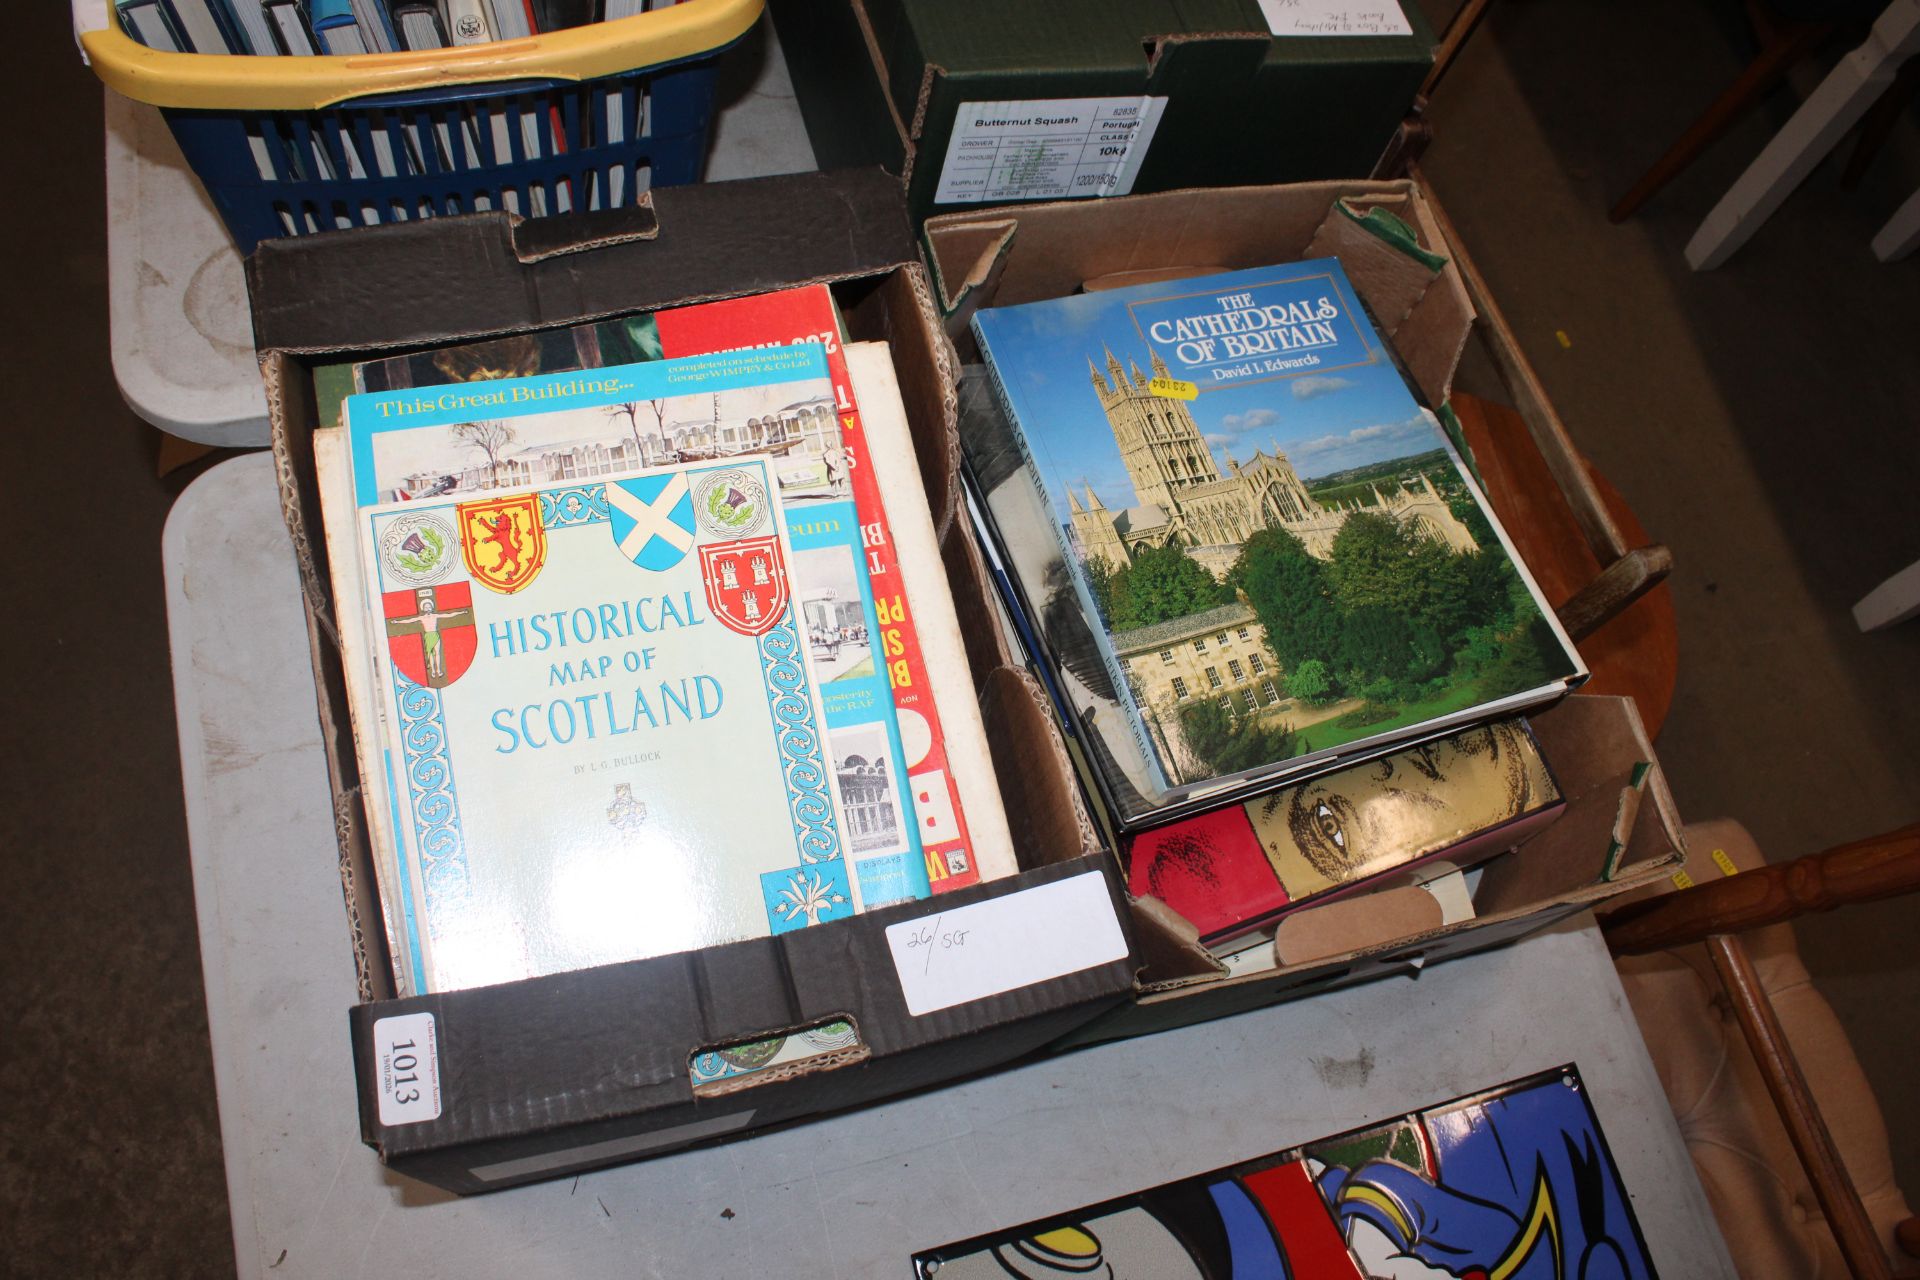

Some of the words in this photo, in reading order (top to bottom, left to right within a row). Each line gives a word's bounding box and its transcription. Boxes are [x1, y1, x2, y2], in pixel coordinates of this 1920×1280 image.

[975, 118, 1031, 128] Butternut
[1034, 116, 1078, 126] Squash
[1102, 121, 1139, 129] Portugal
[1217, 293, 1255, 311] THE
[1150, 296, 1338, 344] CATHEDRALS
[1176, 339, 1217, 365] OF
[1221, 321, 1338, 359] BRITAIN
[667, 372, 709, 384] George
[708, 365, 762, 378] WIMPEY
[763, 364, 775, 372] &
[668, 359, 727, 375] completed
[728, 358, 743, 366] on
[743, 352, 793, 365] schedule
[794, 350, 808, 360] by
[1213, 366, 1252, 381] David
[1265, 354, 1320, 373] Edwards
[375, 398, 435, 417] This
[438, 389, 505, 411] Great
[510, 378, 635, 402] Building...
[488, 591, 705, 658] HISTORICAL
[550, 655, 613, 687] MAP
[623, 647, 656, 673] OF
[491, 674, 724, 754] SCOTLAND
[1105, 656, 1123, 697] PITKIN
[1121, 698, 1152, 769] PICTORIALS
[613, 750, 662, 768] BULLOCK
[863, 856, 902, 869] DISPLAYS
[392, 1038, 420, 1105] 1013
